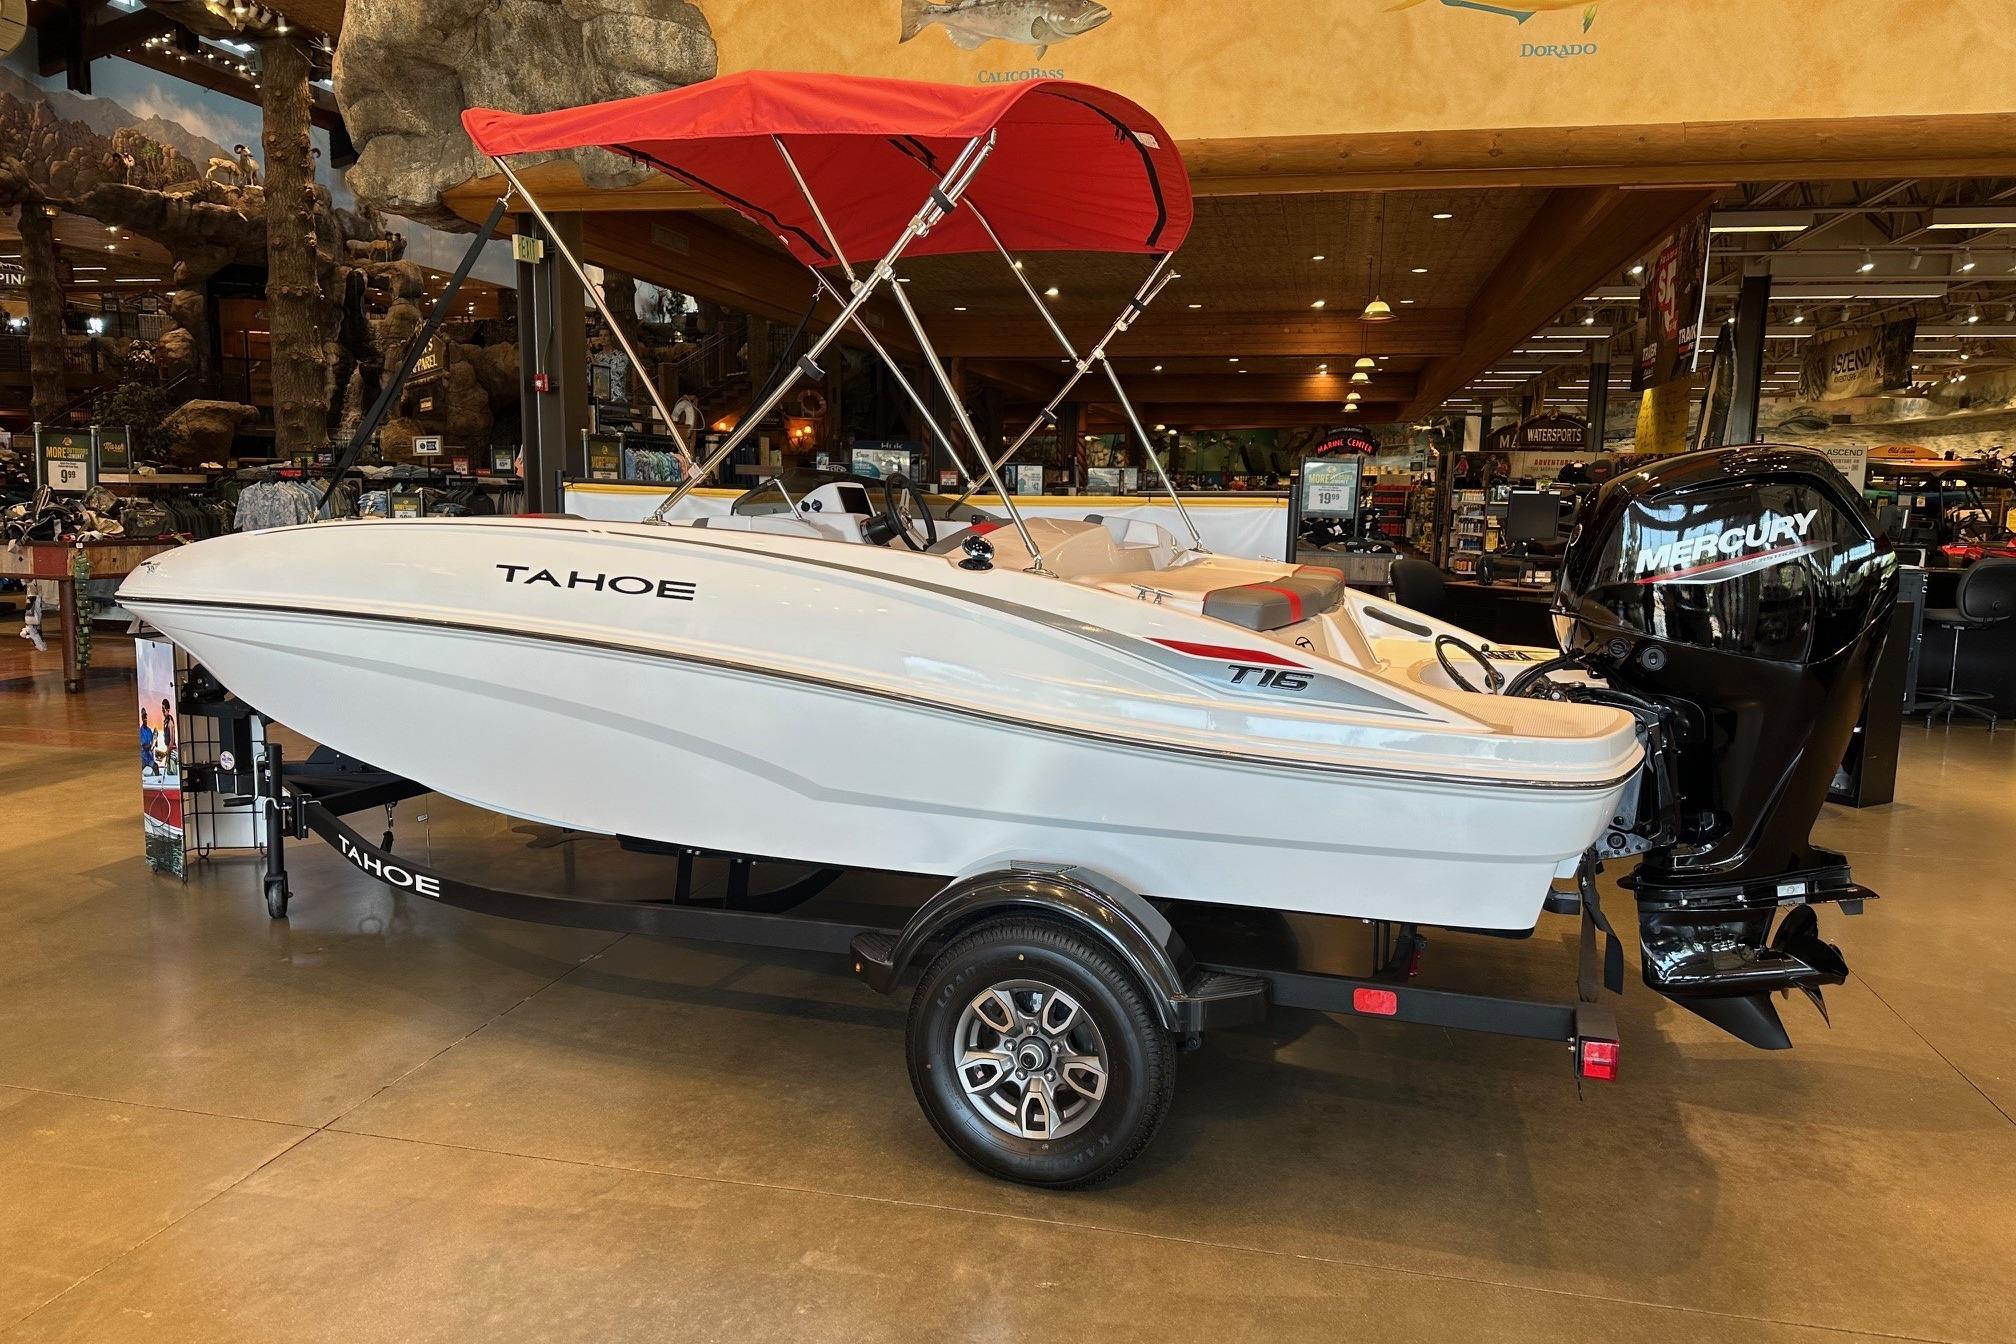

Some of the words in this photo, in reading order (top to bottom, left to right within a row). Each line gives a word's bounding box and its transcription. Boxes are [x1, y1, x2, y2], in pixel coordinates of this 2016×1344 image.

[1520, 43, 1598, 58] DORADO
[1831, 345, 1873, 375] ASCEND
[1527, 428, 1582, 442] WATERSPORTS
[46, 446, 66, 459] MORE
[1317, 439, 1344, 454] MARINE
[1347, 437, 1373, 455] CENTER
[1827, 449, 1863, 457] ASCEND
[1309, 473, 1328, 483] MORE
[1635, 508, 1818, 574] MERCURY
[496, 564, 697, 601] TAHOE
[1227, 664, 1314, 692] T16
[339, 834, 440, 898] TAHOE
